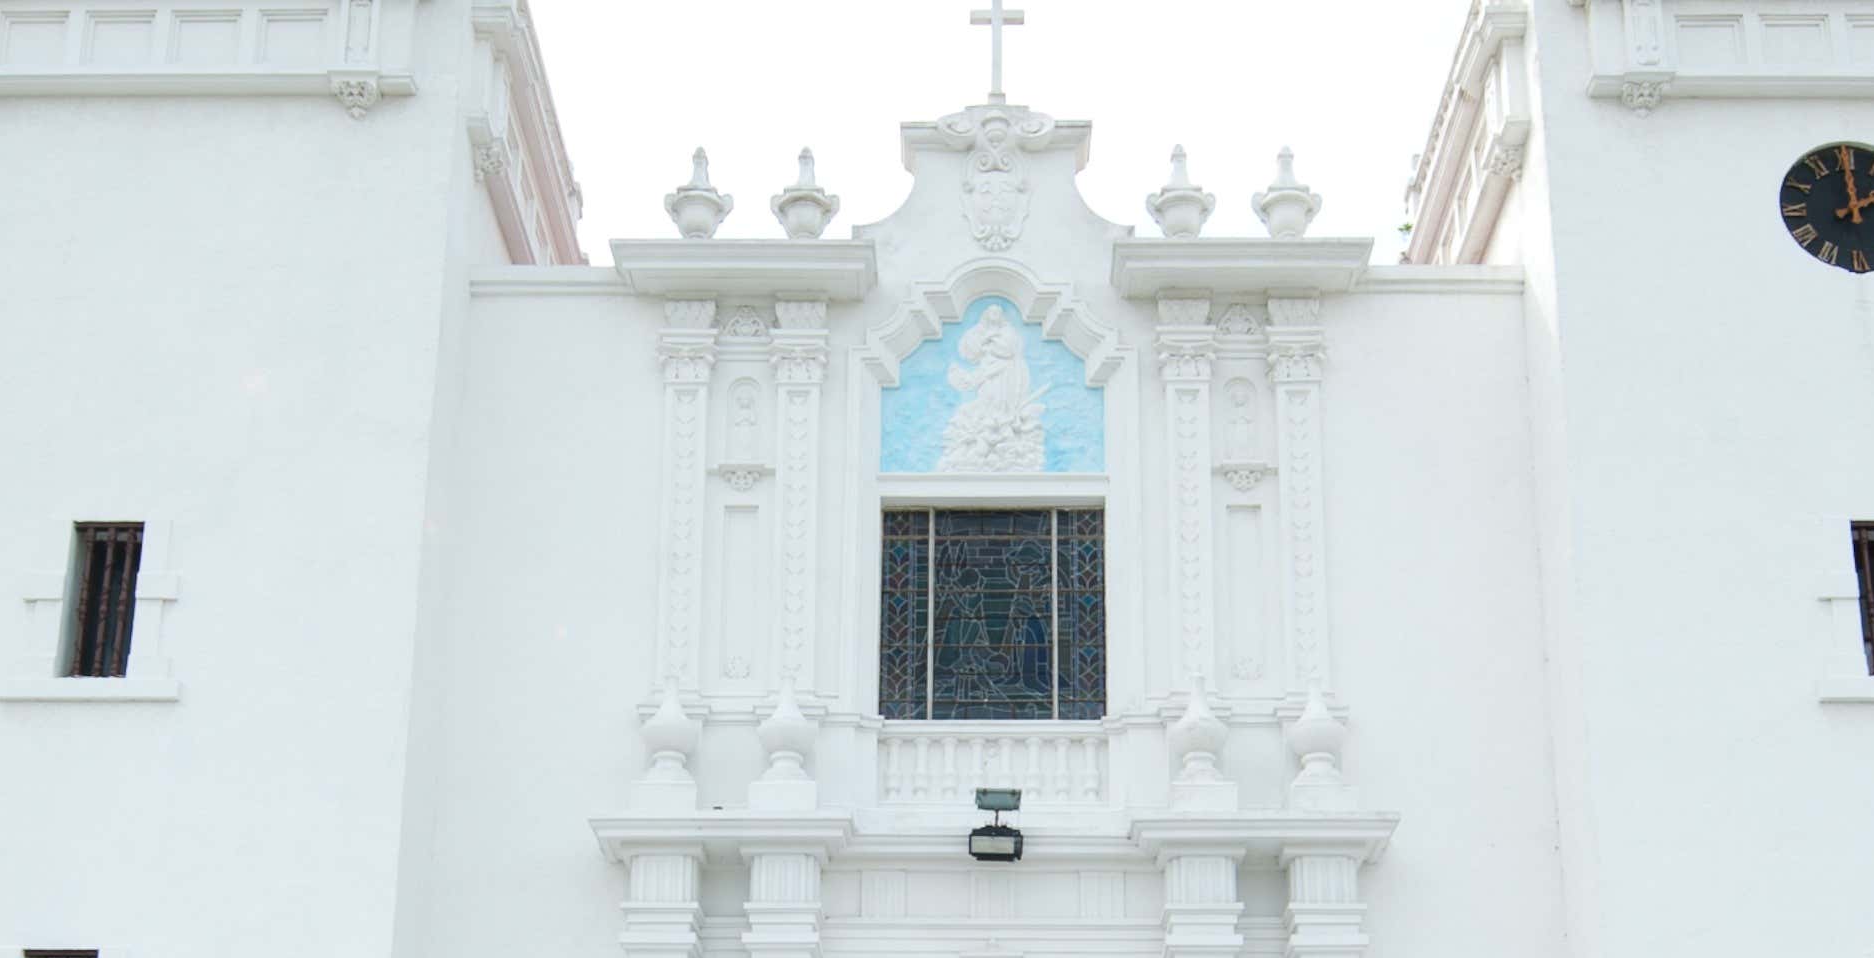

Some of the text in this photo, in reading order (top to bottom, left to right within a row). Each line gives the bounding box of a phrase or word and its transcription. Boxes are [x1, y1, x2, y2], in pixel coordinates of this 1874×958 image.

[1806, 155, 1829, 179] XI
[1786, 177, 1812, 194] X
[1782, 203, 1806, 216] IX
[1792, 223, 1817, 247] VIII
[1818, 241, 1838, 264] VII
[1852, 250, 1870, 270] VI
